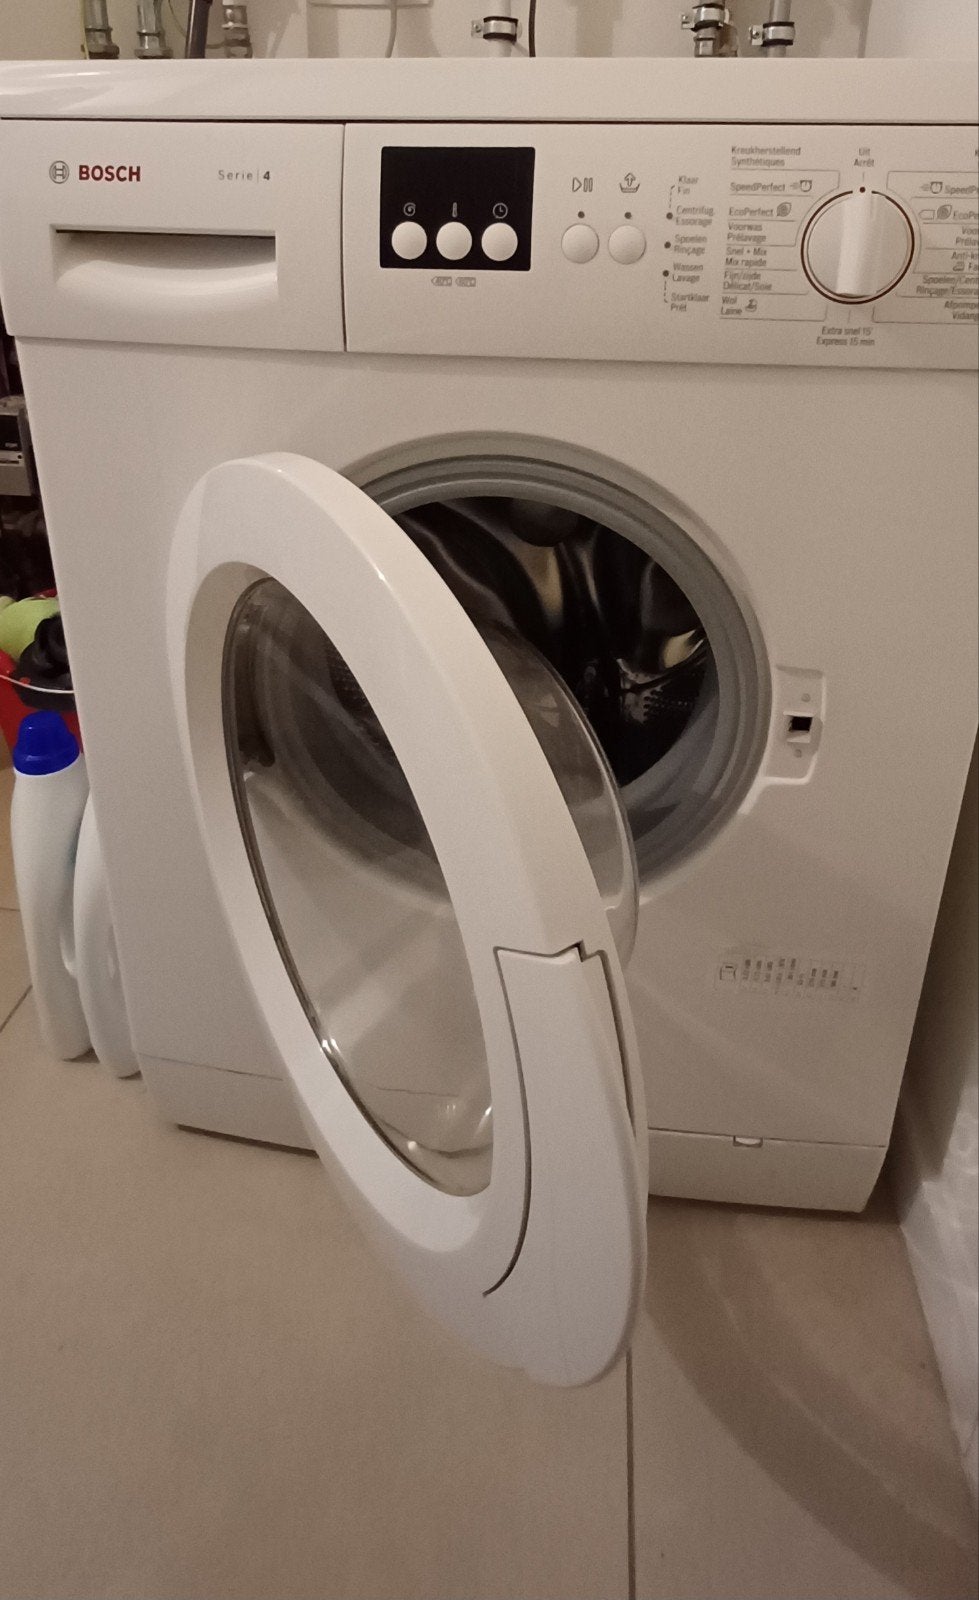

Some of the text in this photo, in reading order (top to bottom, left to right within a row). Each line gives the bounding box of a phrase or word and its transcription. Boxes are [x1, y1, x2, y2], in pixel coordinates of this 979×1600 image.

[78, 164, 141, 182] BOSCH
[218, 169, 271, 181] Serie 4
[730, 182, 786, 192] SpeedPerfect
[728, 206, 774, 217] EcoPerfect
